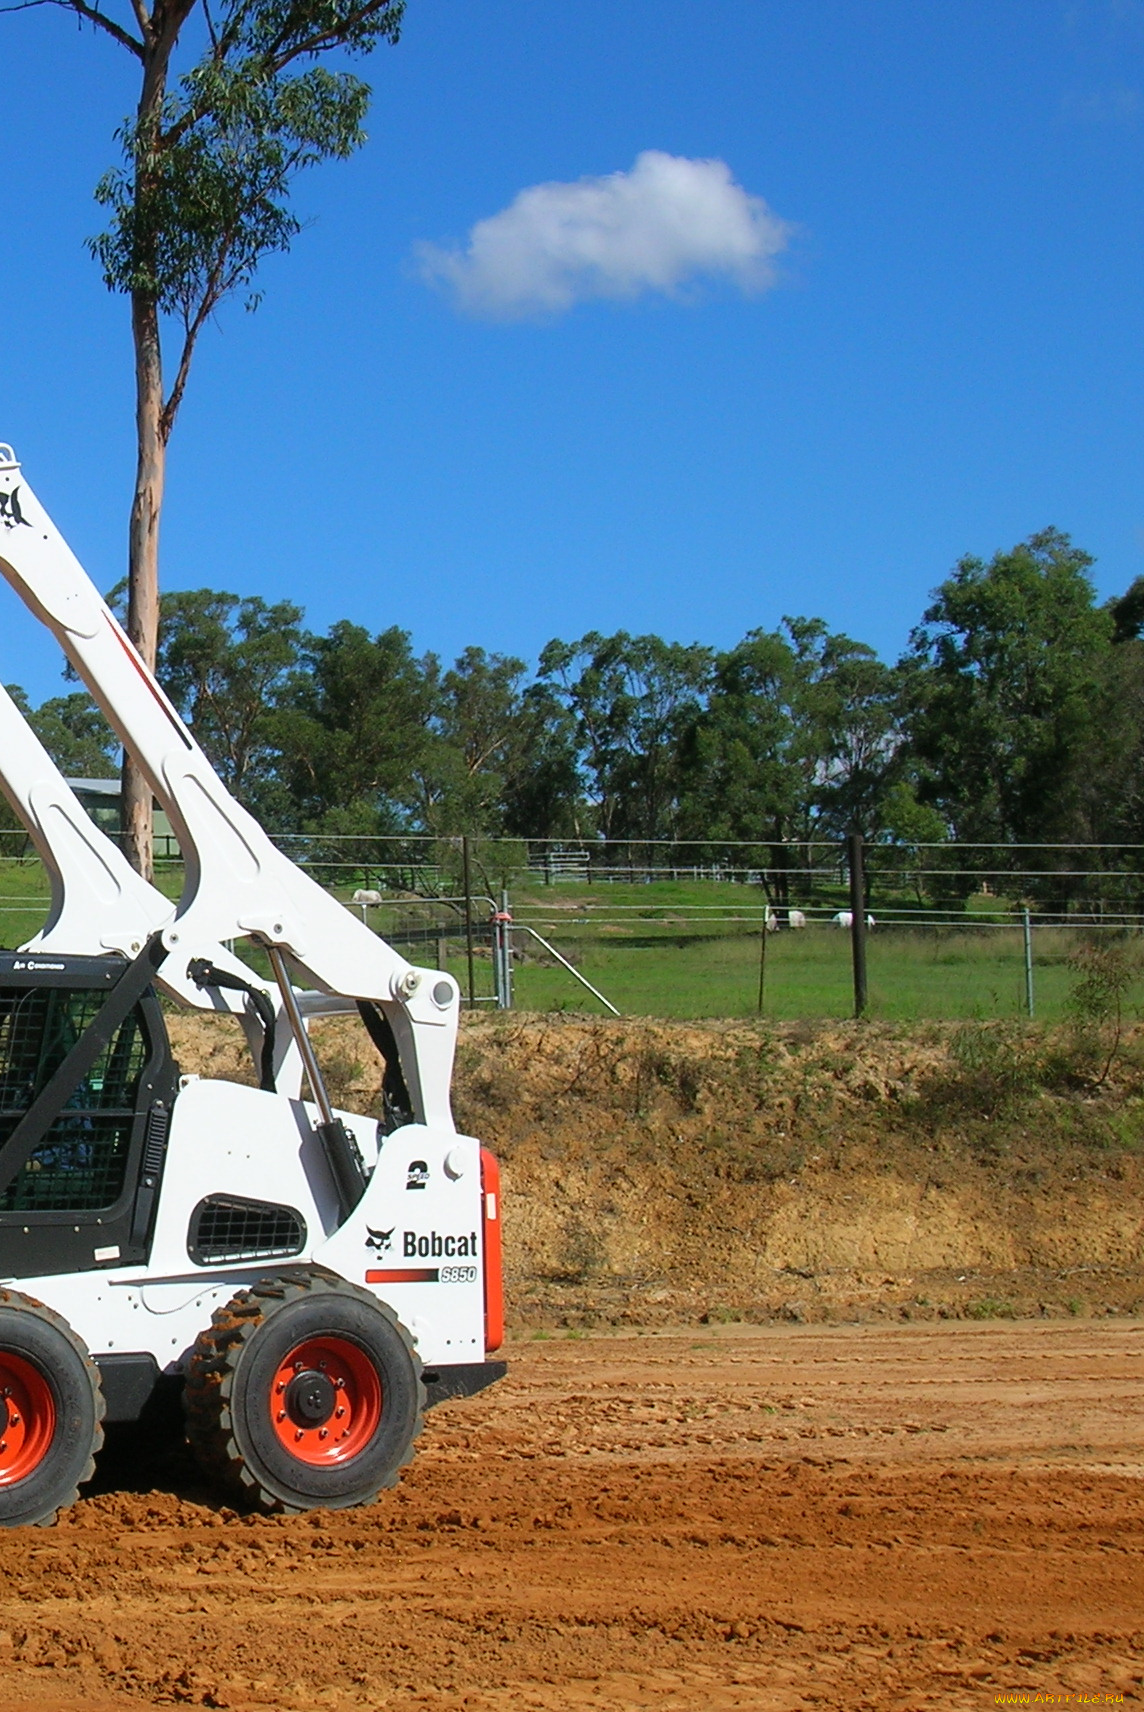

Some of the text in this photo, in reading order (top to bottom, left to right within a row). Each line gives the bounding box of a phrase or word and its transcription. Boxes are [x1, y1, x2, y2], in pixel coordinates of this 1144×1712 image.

[406, 1160, 428, 1190] 2
[403, 1231, 477, 1257] Bobcat
[440, 1266, 477, 1283] S850
